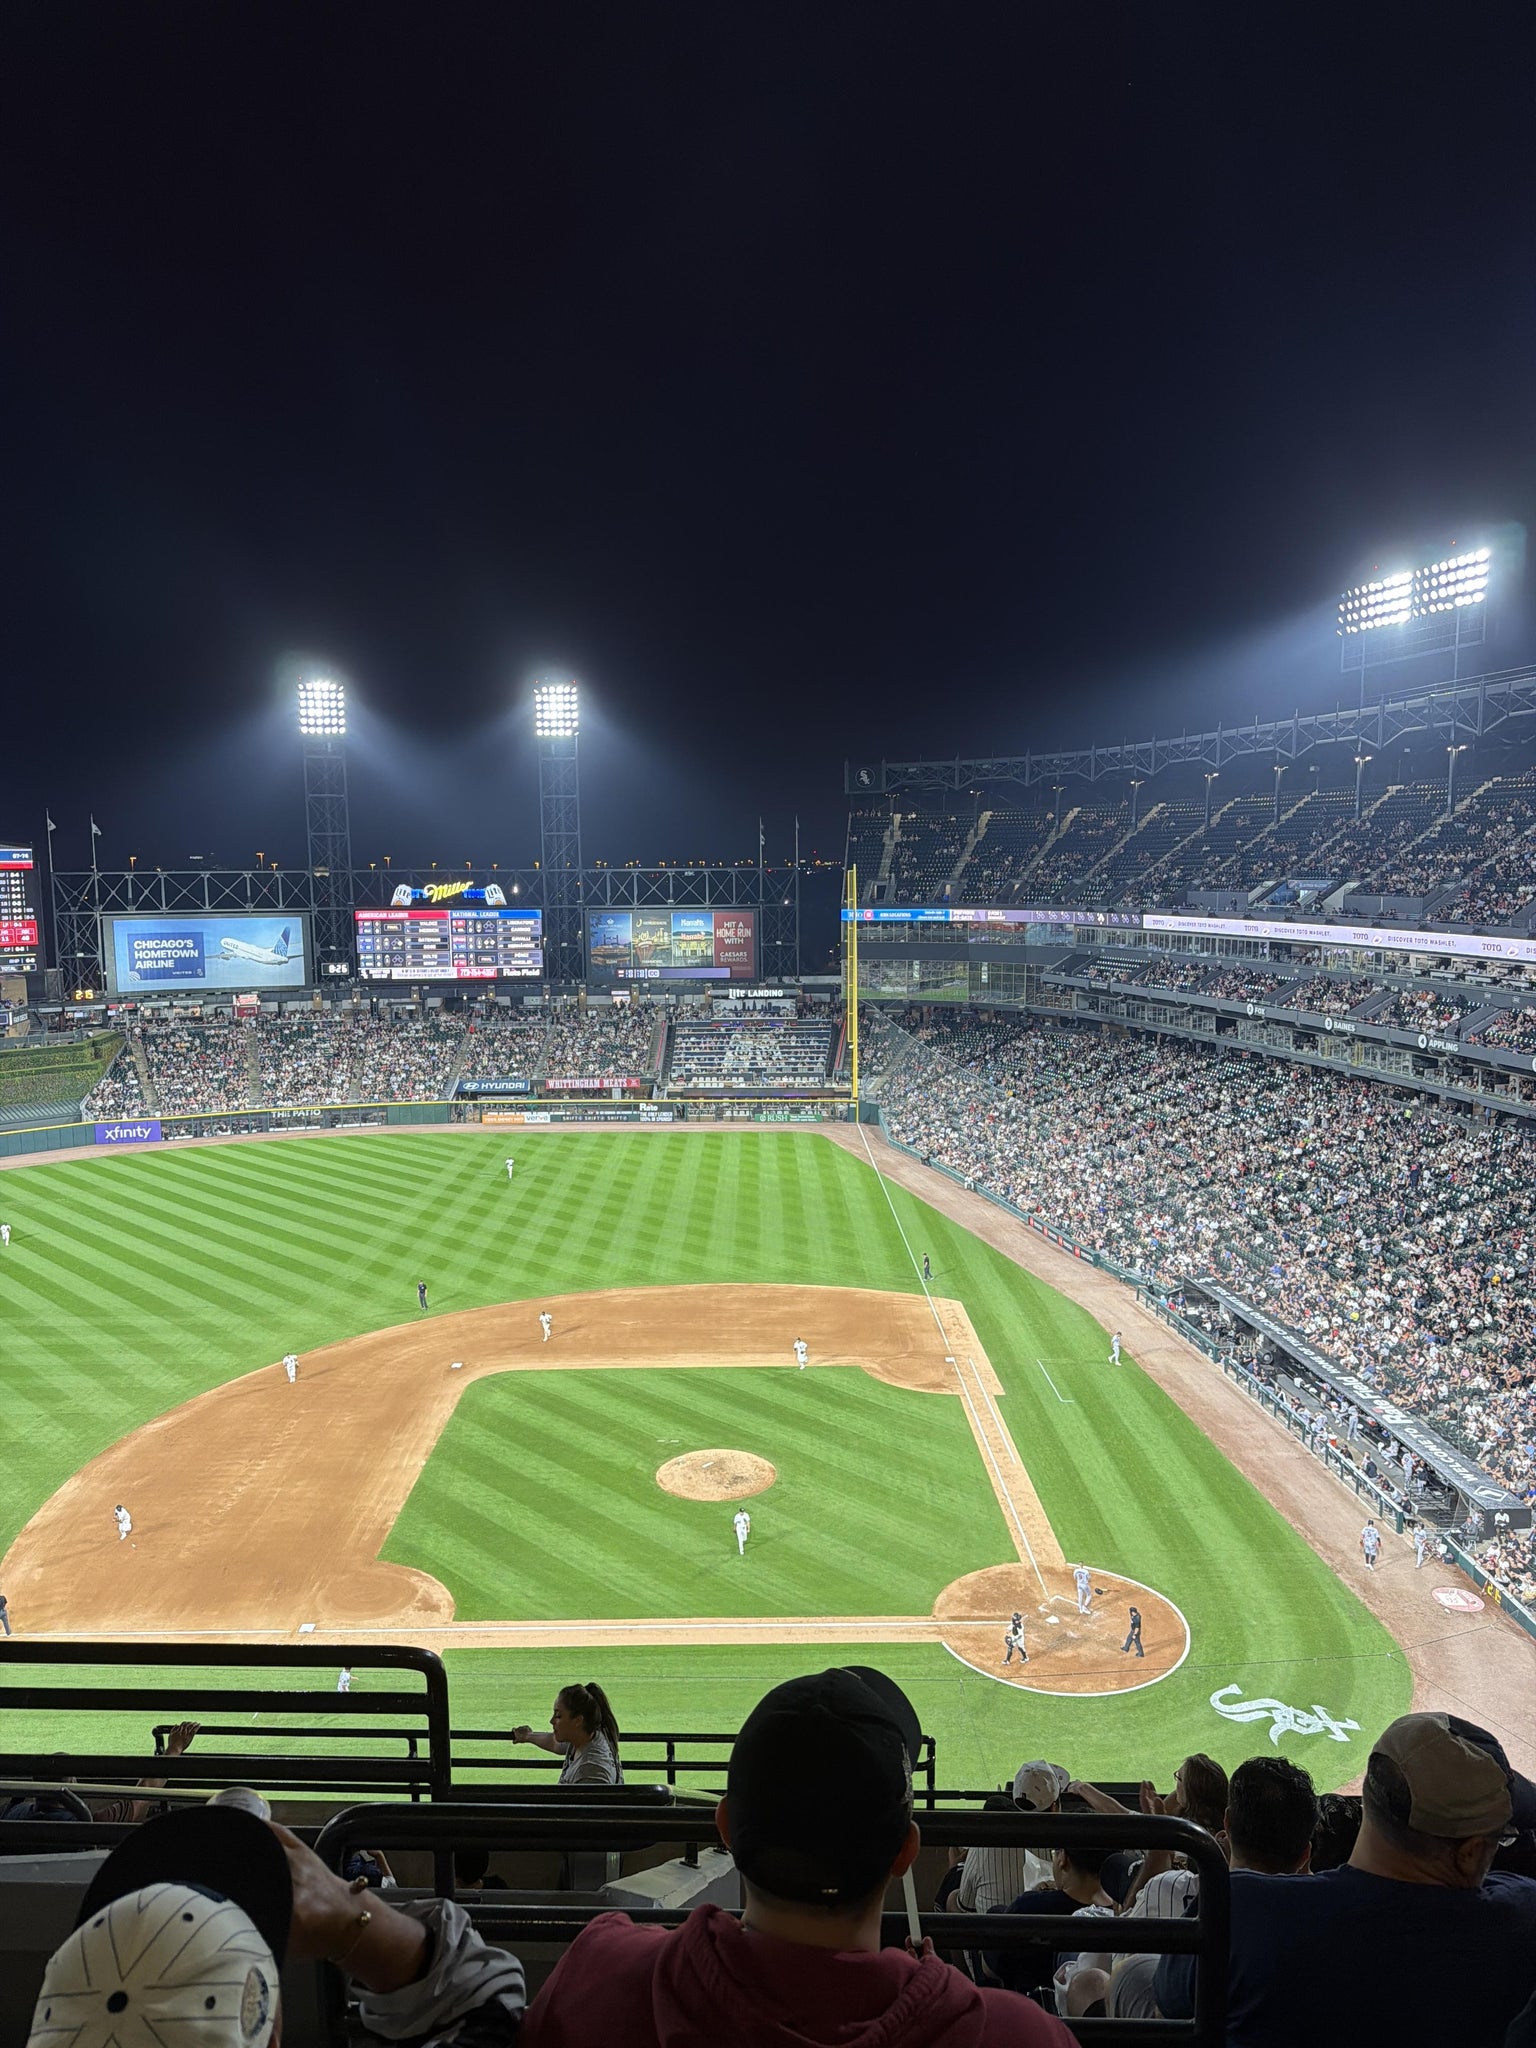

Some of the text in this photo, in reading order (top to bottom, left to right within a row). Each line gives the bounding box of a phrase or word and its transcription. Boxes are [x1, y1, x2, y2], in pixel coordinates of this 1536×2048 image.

[424, 881, 474, 903] Miller
[716, 928, 751, 937] HOME RUN
[134, 939, 194, 949] CHICAGO'S
[1388, 935, 1413, 943] DISCOVER
[223, 941, 239, 950] UNITED
[1482, 943, 1502, 952] TOTO
[134, 949, 198, 959] HOMETOWN
[135, 960, 174, 969] AIRLINE
[728, 989, 745, 999] Lite
[1334, 1021, 1355, 1032] BAINES
[1428, 1040, 1458, 1052] APPLING
[549, 1079, 600, 1089] WHITTINGHAM
[603, 1079, 628, 1087] MEATS
[293, 1109, 321, 1118] PATIO
[104, 1126, 152, 1141] xfinity
[1211, 1286, 1478, 1482] WELCOME TO Rate Field HOME OF THE CHICAGO WHITE SOX
